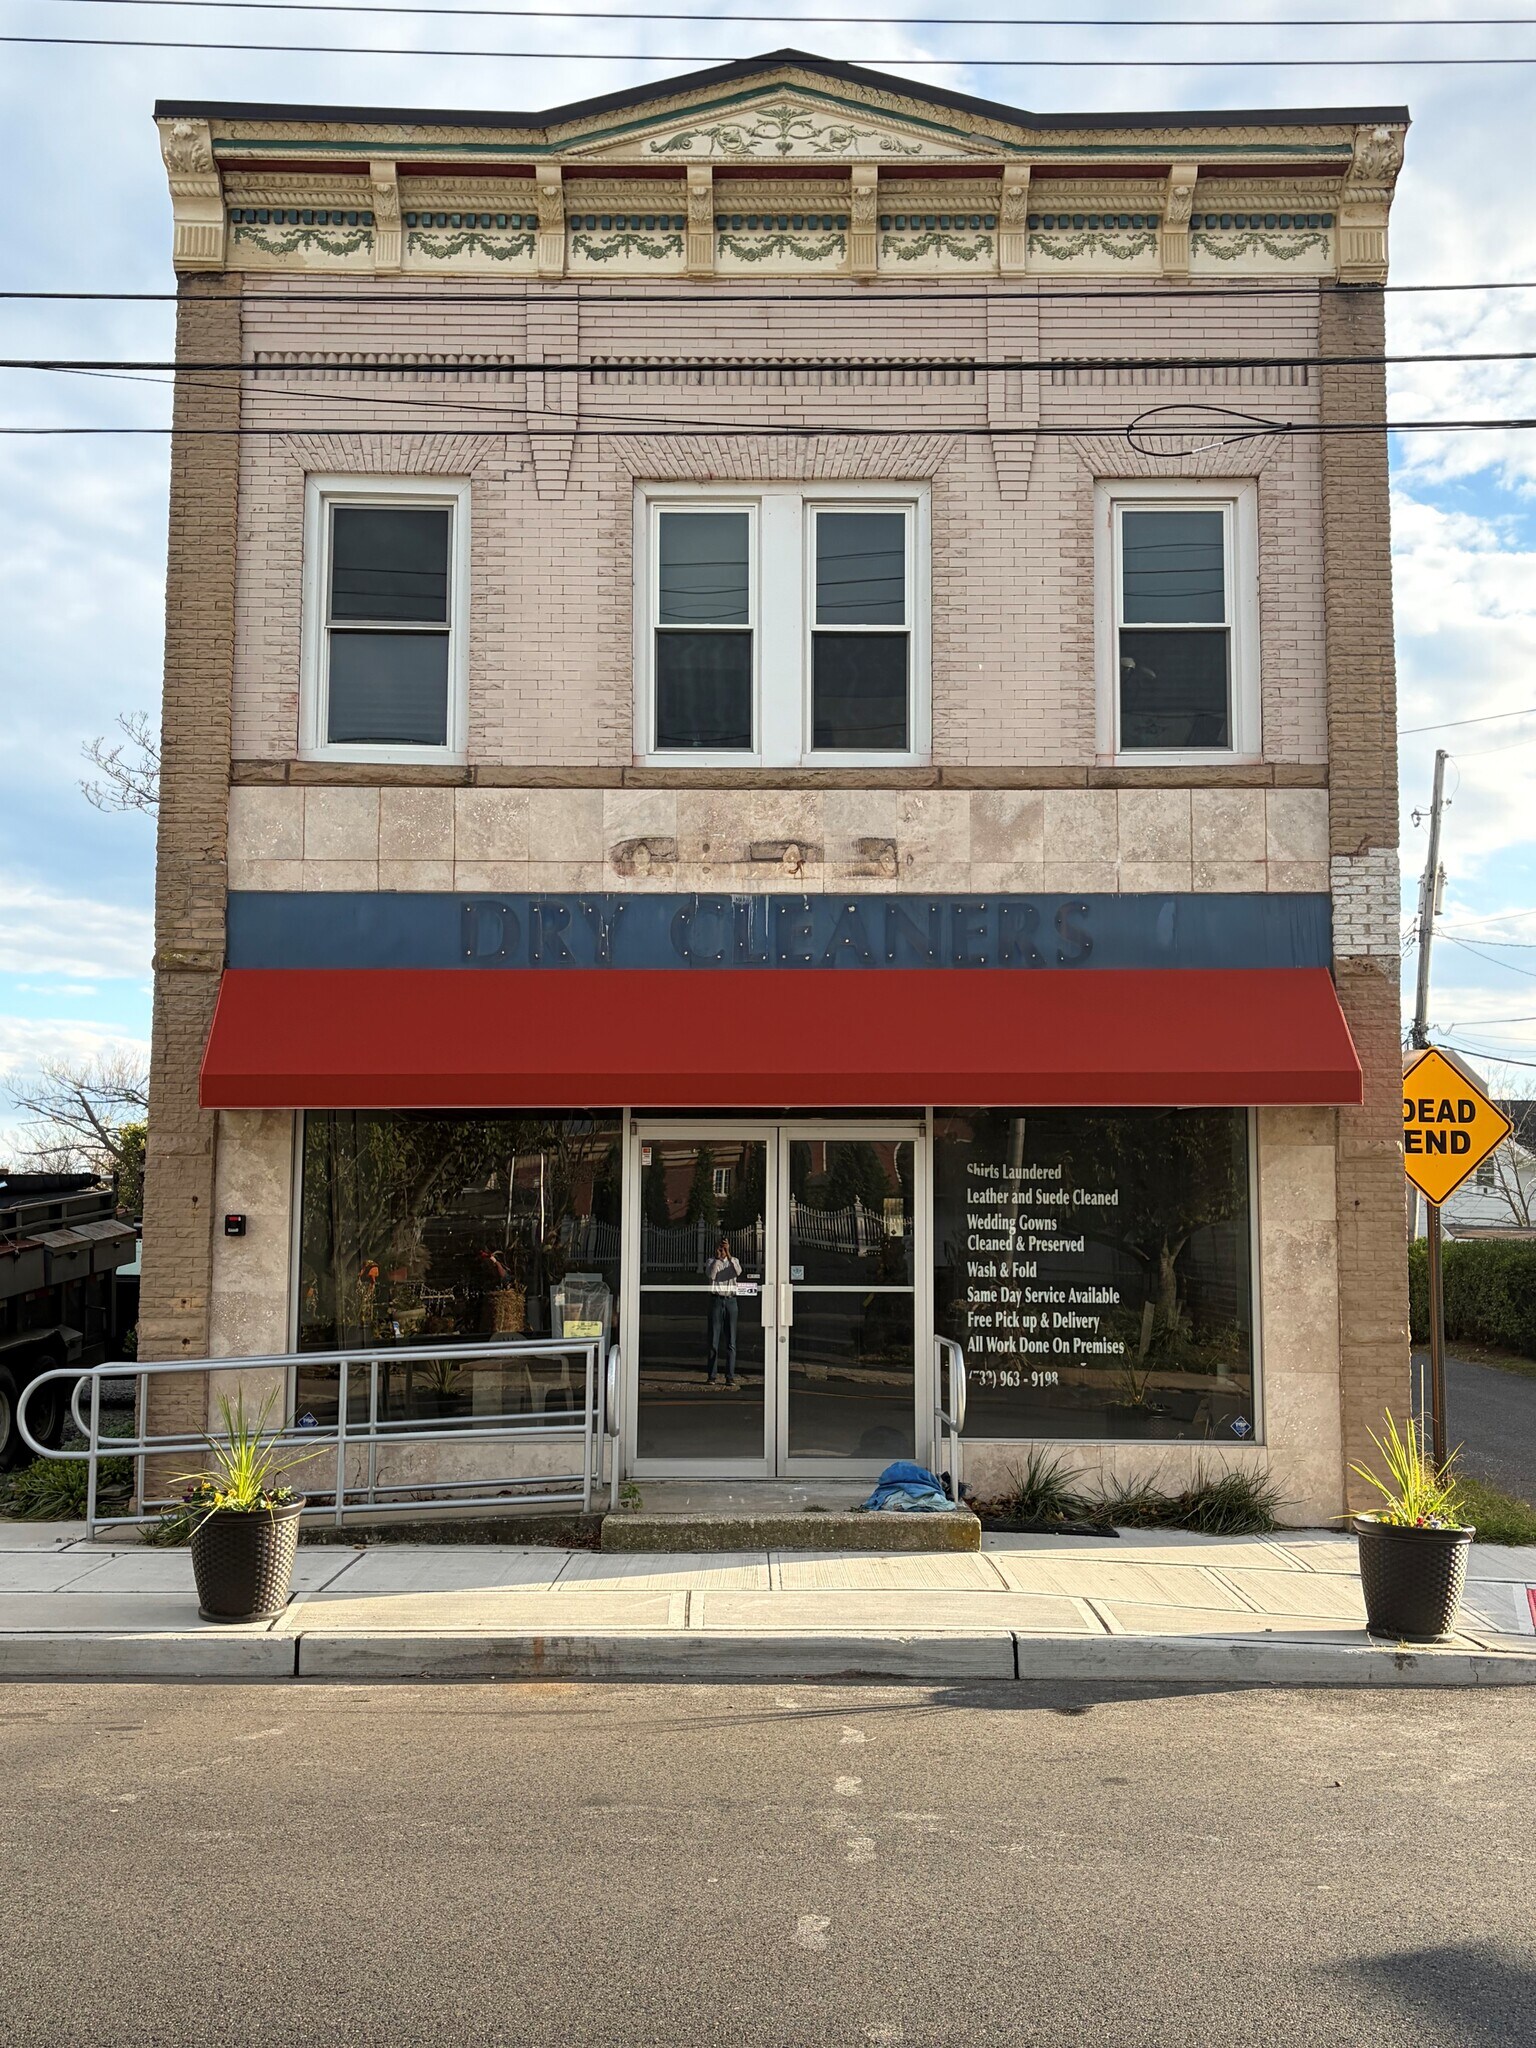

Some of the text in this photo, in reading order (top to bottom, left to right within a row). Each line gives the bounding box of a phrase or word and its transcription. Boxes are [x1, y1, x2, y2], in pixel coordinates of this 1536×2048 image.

[461, 900, 1093, 967] DRY CLEANERS
[1403, 1099, 1476, 1123] DEAD
[1404, 1130, 1471, 1154] END
[967, 1163, 1062, 1180] Shirts Laundered
[967, 1187, 1119, 1206] Leather and Suede Cleaned
[967, 1213, 1057, 1235] Wedding Gowns
[967, 1234, 1085, 1252] Cleaned & Preserved
[967, 1261, 1037, 1278] Wash & Fold
[967, 1286, 1120, 1307] Same Day Service Available
[967, 1312, 1100, 1333] Free Pick up & Delivery
[967, 1337, 1124, 1354] All Work Done On Premises
[1000, 1370, 1020, 1387] 963
[1031, 1371, 1059, 1387] 9198
